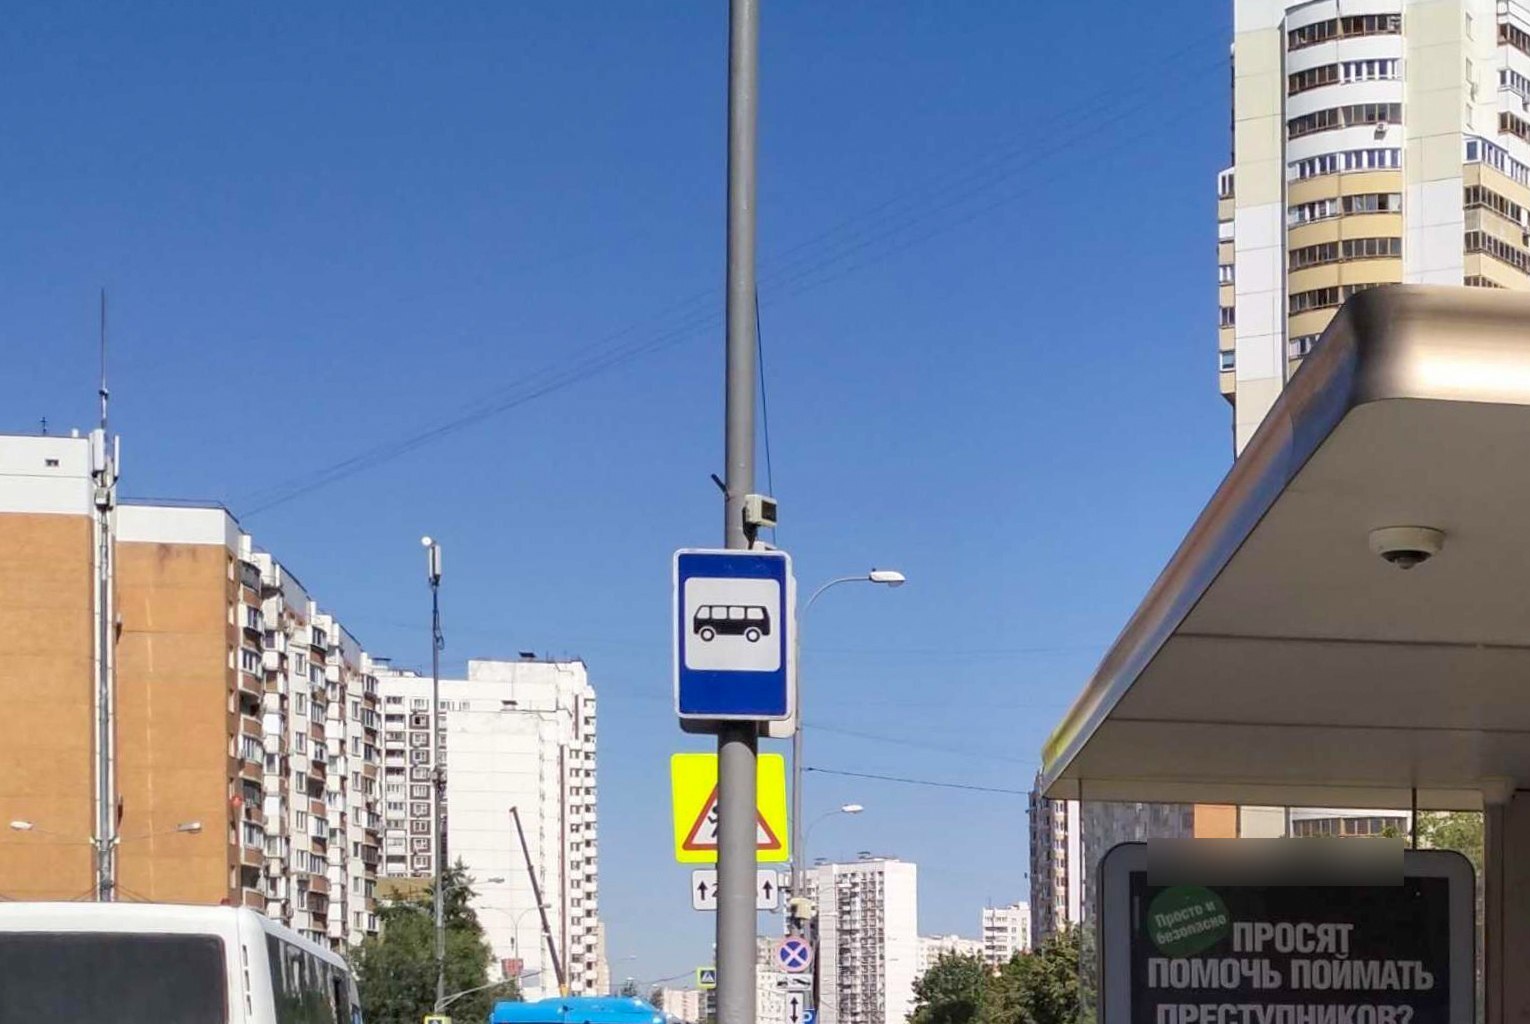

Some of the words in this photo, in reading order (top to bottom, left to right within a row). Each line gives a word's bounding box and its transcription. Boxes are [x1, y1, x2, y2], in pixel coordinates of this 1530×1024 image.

[1154, 904, 1204, 928] Просто
[1156, 914, 1227, 945] безопасно
[1232, 921, 1355, 954] ПРОСЯТ
[1148, 957, 1283, 990] ПОМОЧЬ
[1290, 953, 1435, 991] ПОЙМАТЬ
